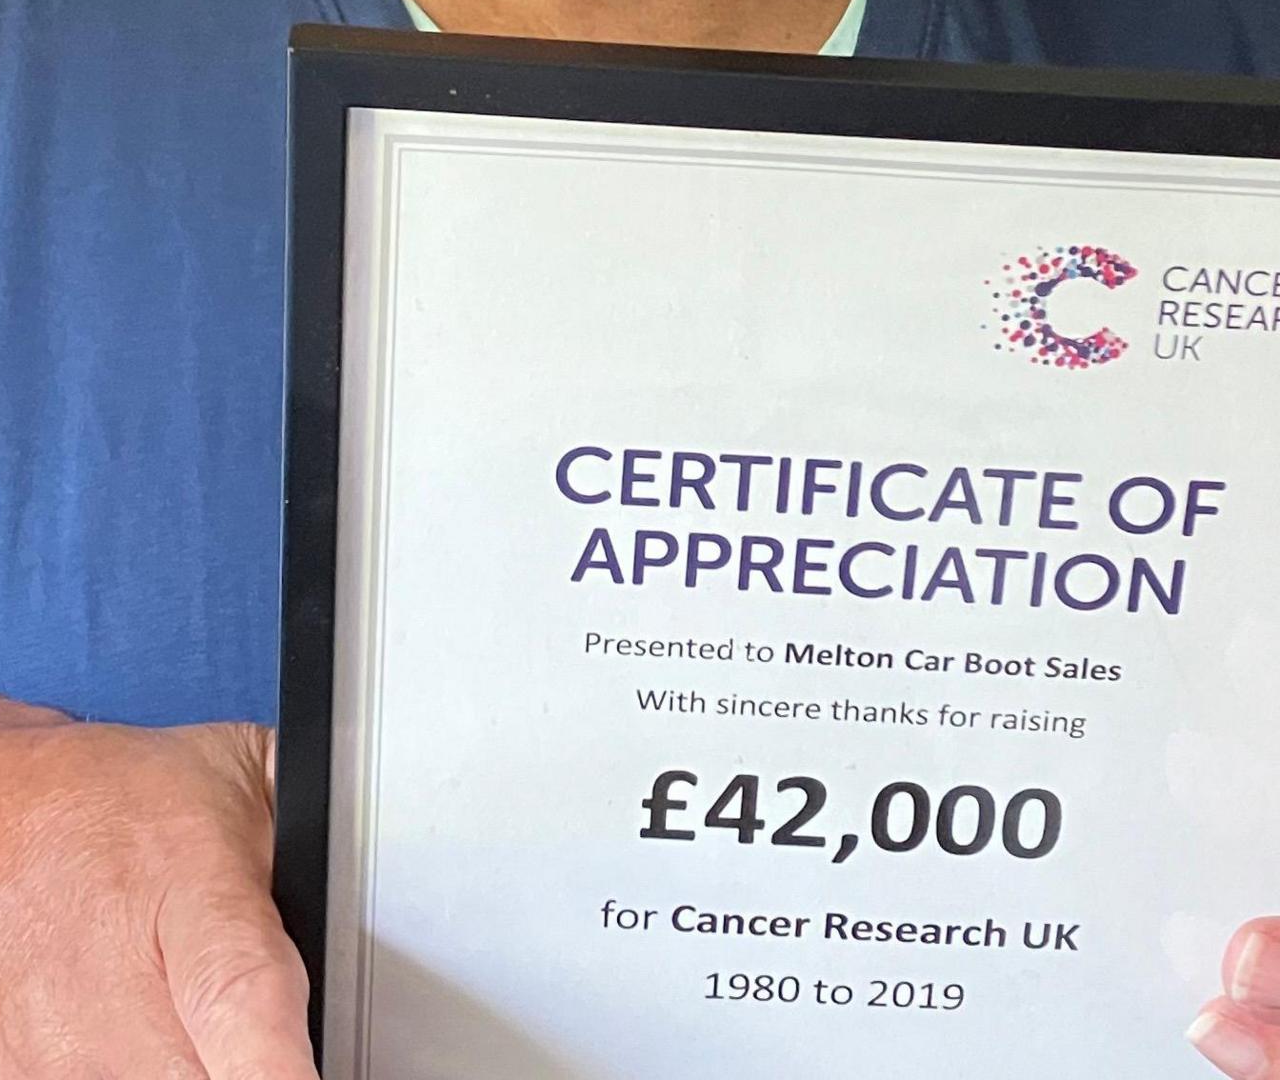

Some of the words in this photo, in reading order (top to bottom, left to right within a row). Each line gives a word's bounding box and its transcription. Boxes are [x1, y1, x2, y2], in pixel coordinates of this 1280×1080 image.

[1154, 333, 1203, 361] UK
[555, 446, 1083, 531] CERTIFICATE
[1108, 476, 1227, 537] OF
[570, 527, 1186, 615] APPRECIATION
[584, 632, 734, 661] Presented
[744, 641, 775, 663] to
[784, 642, 894, 670] Melton
[904, 648, 956, 673] Car
[964, 651, 1037, 678] Boot
[1043, 656, 1122, 682] Sales
[636, 688, 706, 714] With
[715, 693, 822, 720] sincere
[830, 698, 929, 726] thanks
[937, 703, 982, 728] for
[990, 708, 1087, 739] raising
[639, 770, 1063, 865] £42,000
[600, 898, 659, 931] for
[671, 904, 812, 939] Cancer
[823, 912, 1007, 948] Research
[1022, 921, 1081, 952] UK
[704, 972, 801, 1003] 1980
[812, 979, 854, 1006] to
[866, 979, 965, 1011] 2019
